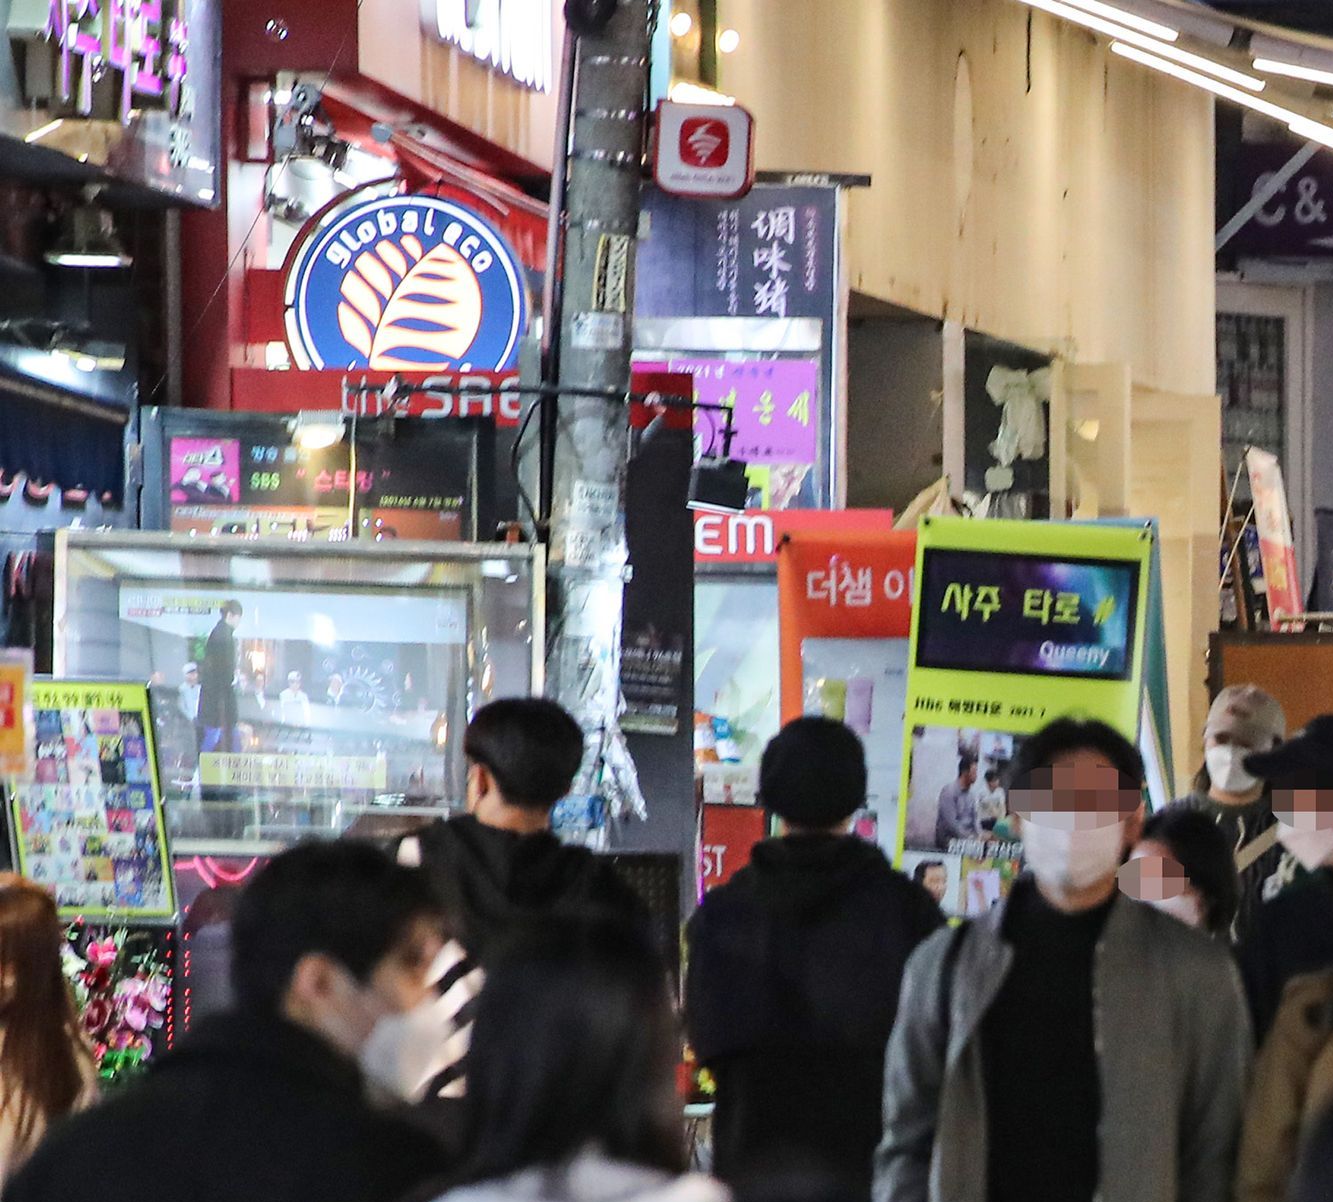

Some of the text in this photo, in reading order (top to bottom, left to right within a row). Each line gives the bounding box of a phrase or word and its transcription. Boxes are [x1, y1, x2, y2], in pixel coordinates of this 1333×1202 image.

[325, 207, 493, 274] global eco
[941, 582, 1081, 626] 사주 타로
[1040, 640, 1110, 667] Queeny
